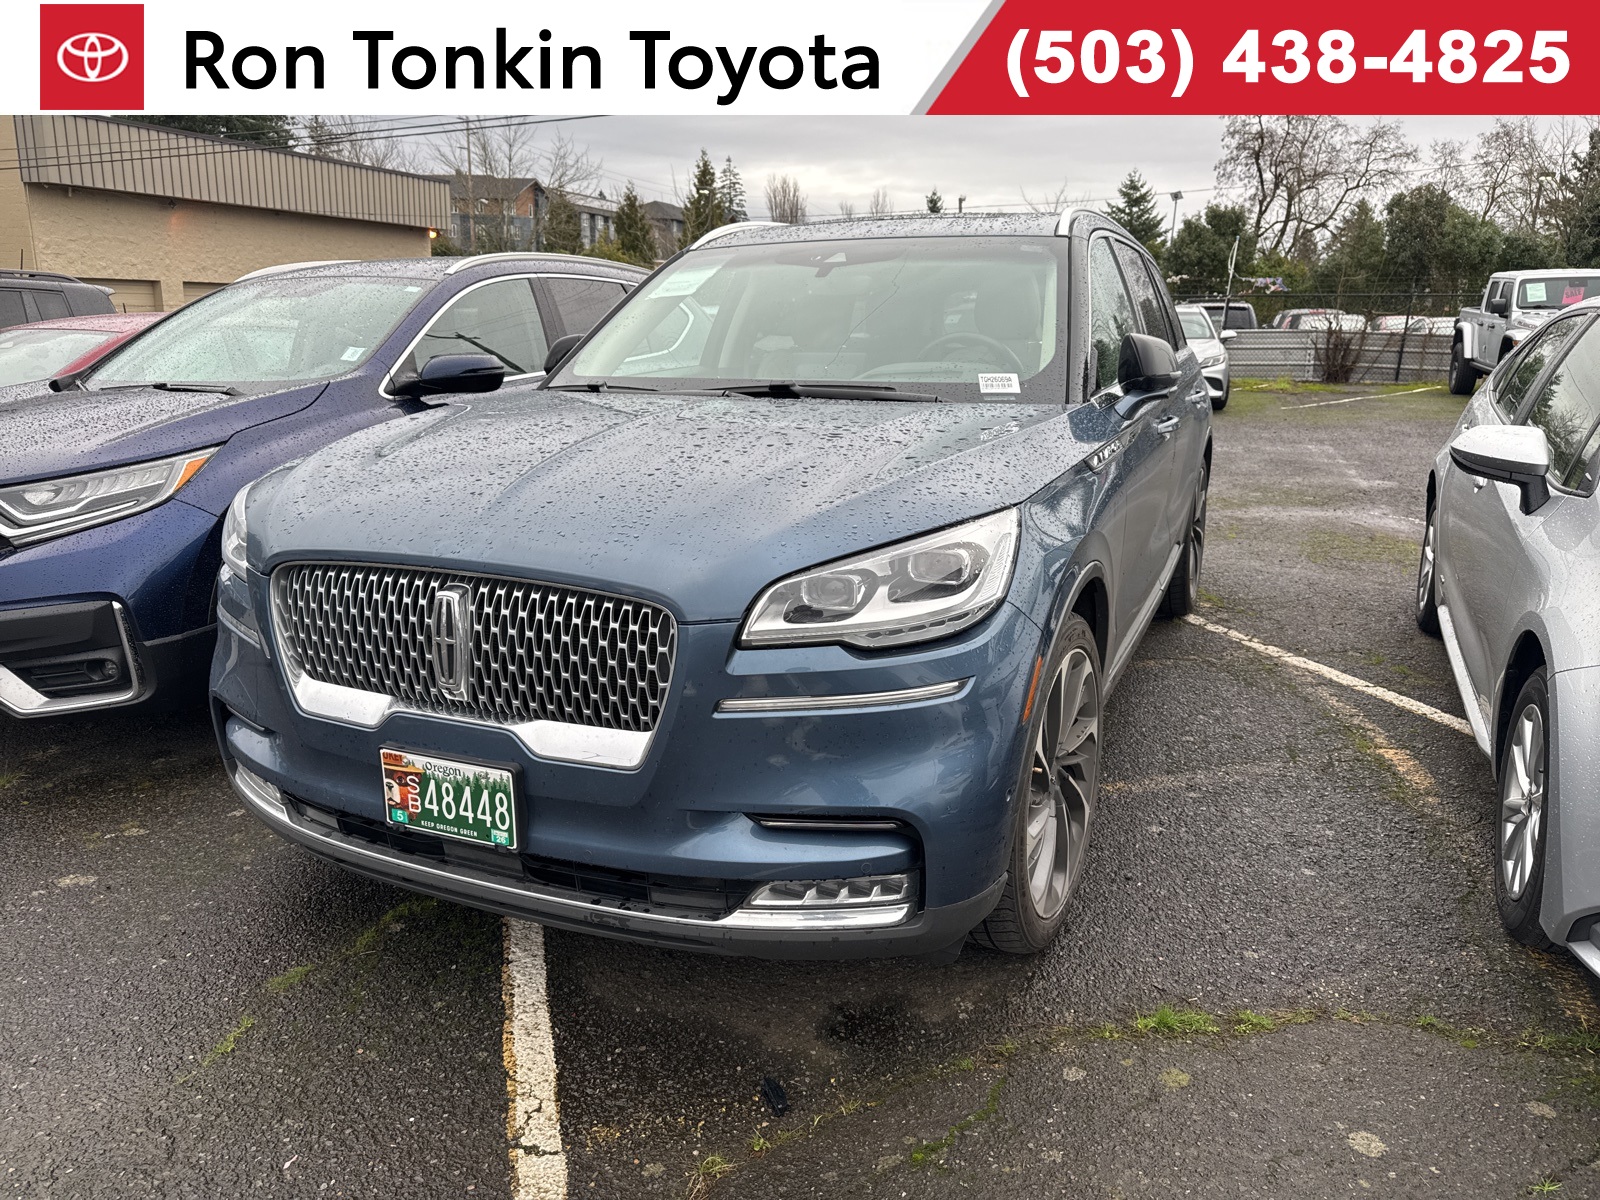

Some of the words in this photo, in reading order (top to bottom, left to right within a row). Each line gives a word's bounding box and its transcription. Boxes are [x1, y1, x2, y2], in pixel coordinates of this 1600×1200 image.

[424, 761, 462, 778] Oregon
[424, 779, 510, 831] 48448
[397, 811, 404, 820] 5
[436, 823, 458, 832] OREGON
[459, 828, 478, 837] GREEN
[496, 834, 506, 843] 26
